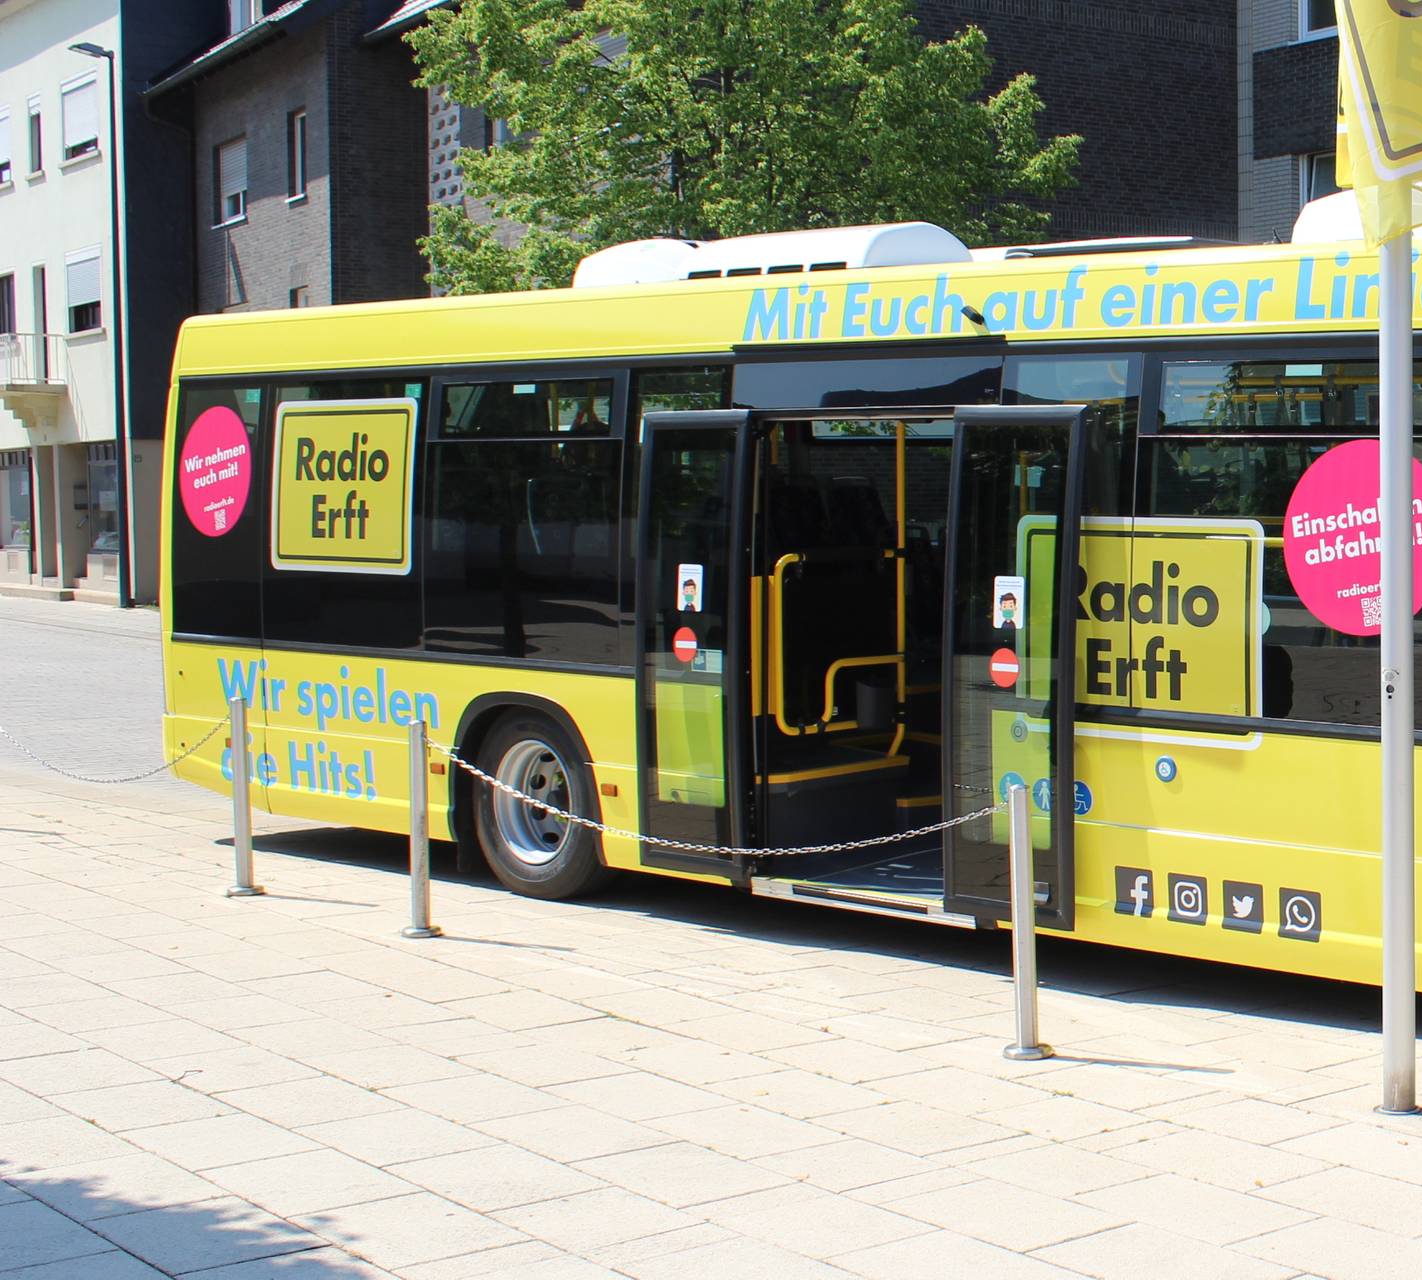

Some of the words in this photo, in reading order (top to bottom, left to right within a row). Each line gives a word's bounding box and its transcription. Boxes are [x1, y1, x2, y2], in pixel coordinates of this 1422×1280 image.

[742, 282, 828, 342] Mit
[841, 272, 965, 338] Euch
[981, 263, 1089, 332] auf
[1100, 262, 1275, 328] einer
[184, 455, 204, 473] Wir
[204, 443, 246, 467] nehmen
[193, 468, 217, 489] euch
[218, 461, 239, 481] mit!
[295, 432, 389, 482] Radio
[311, 489, 370, 540] Erft
[216, 657, 286, 713] Wir
[297, 665, 440, 731] spielen
[1086, 635, 1188, 701] Erft
[287, 740, 378, 801] Hits!
